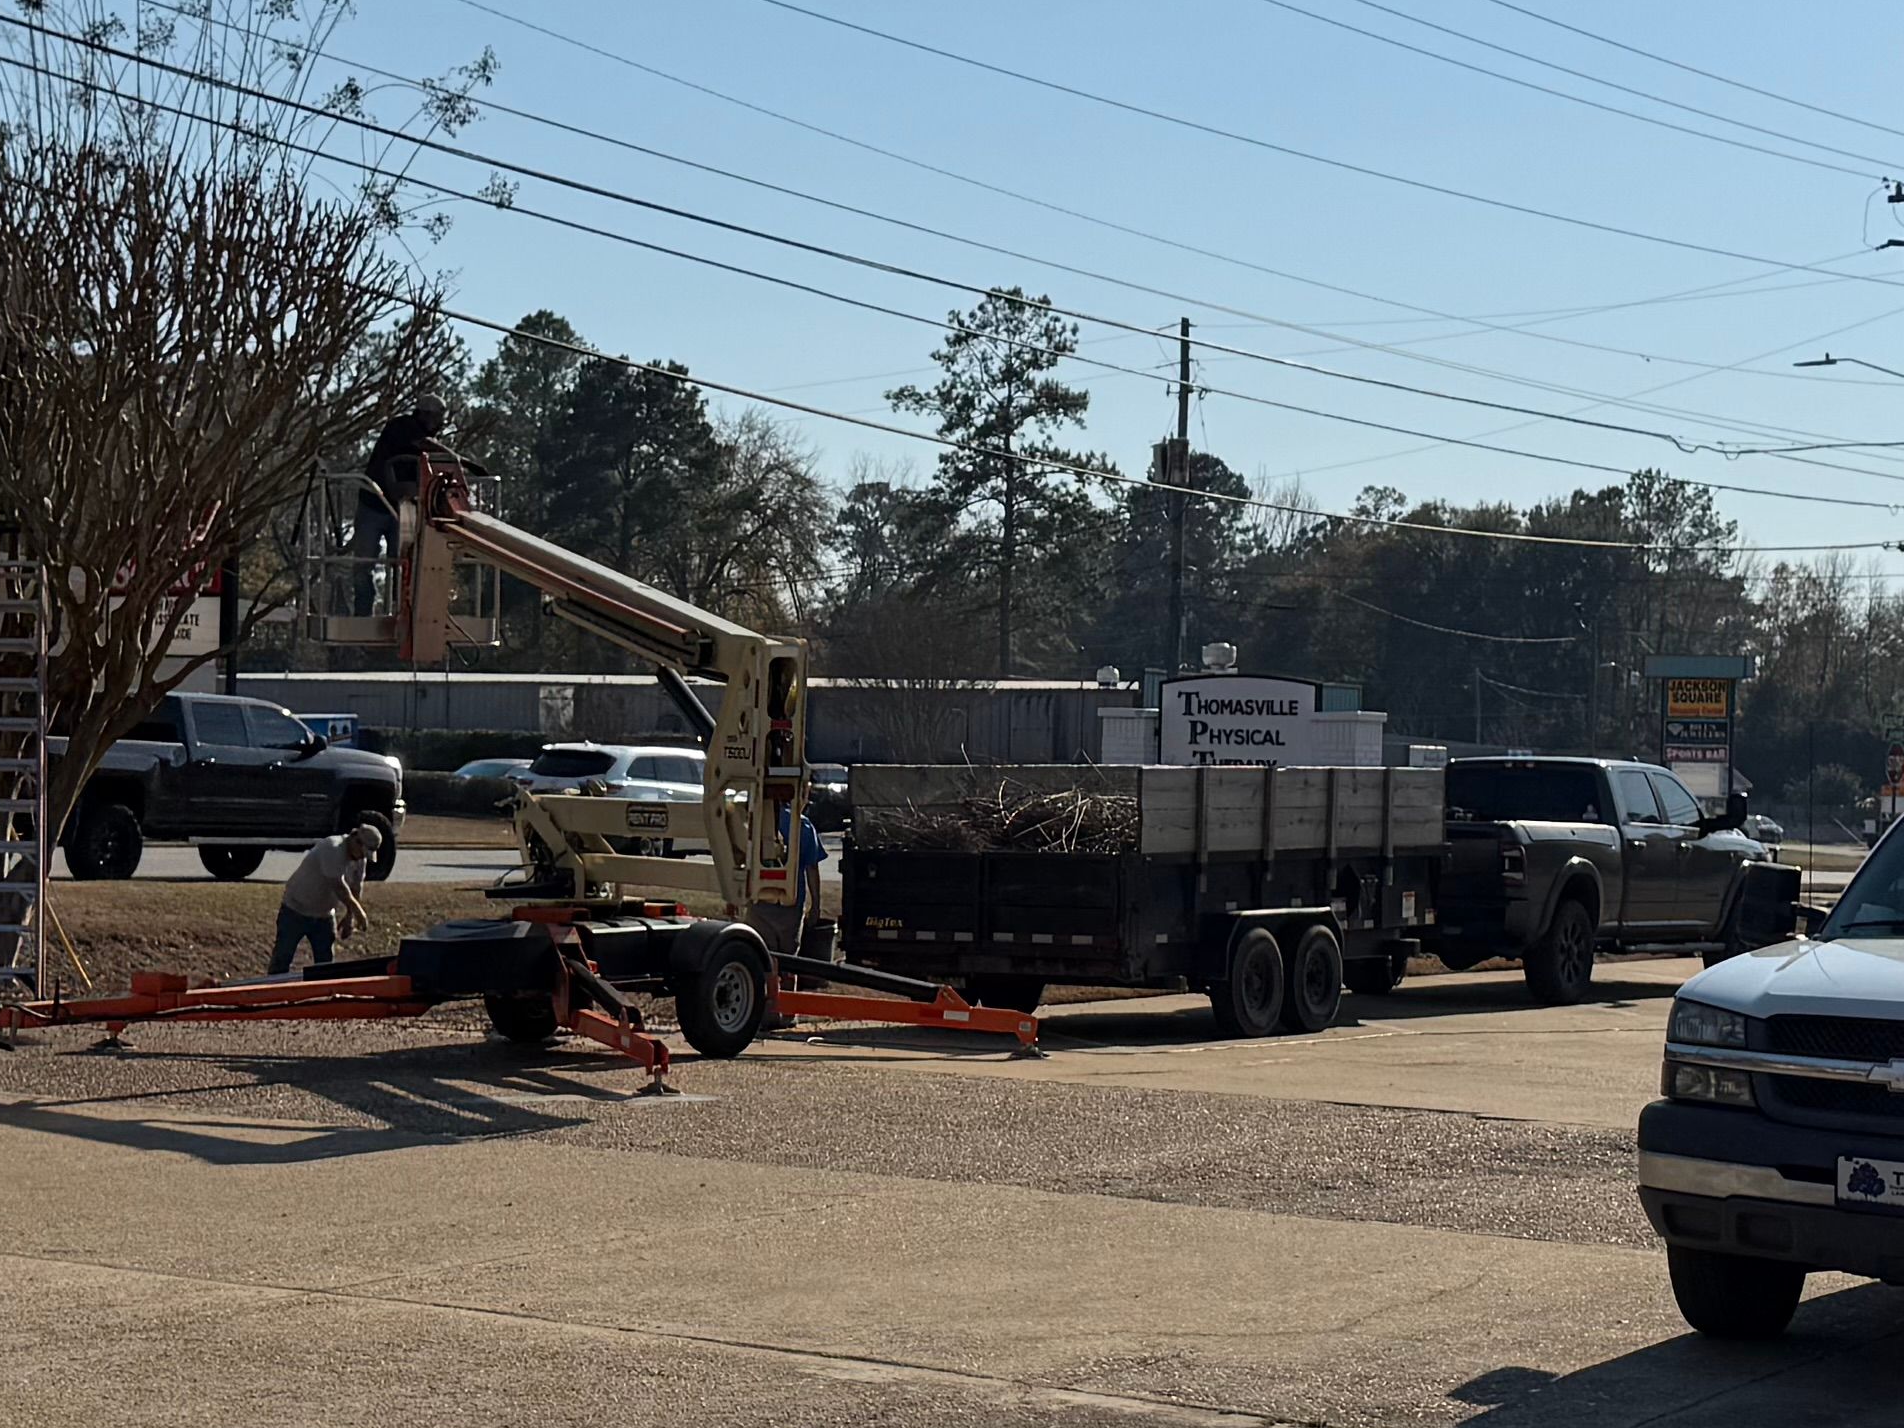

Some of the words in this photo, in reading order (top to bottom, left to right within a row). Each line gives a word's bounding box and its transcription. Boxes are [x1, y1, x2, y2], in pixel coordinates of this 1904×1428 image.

[1669, 680, 1726, 692] JACKSON
[1178, 690, 1299, 716] THOMASVILLE
[1672, 692, 1722, 703] SQUARE
[1188, 720, 1286, 746] PHYSICAL
[1666, 748, 1703, 759] SPORTS
[1706, 748, 1726, 759] BAR
